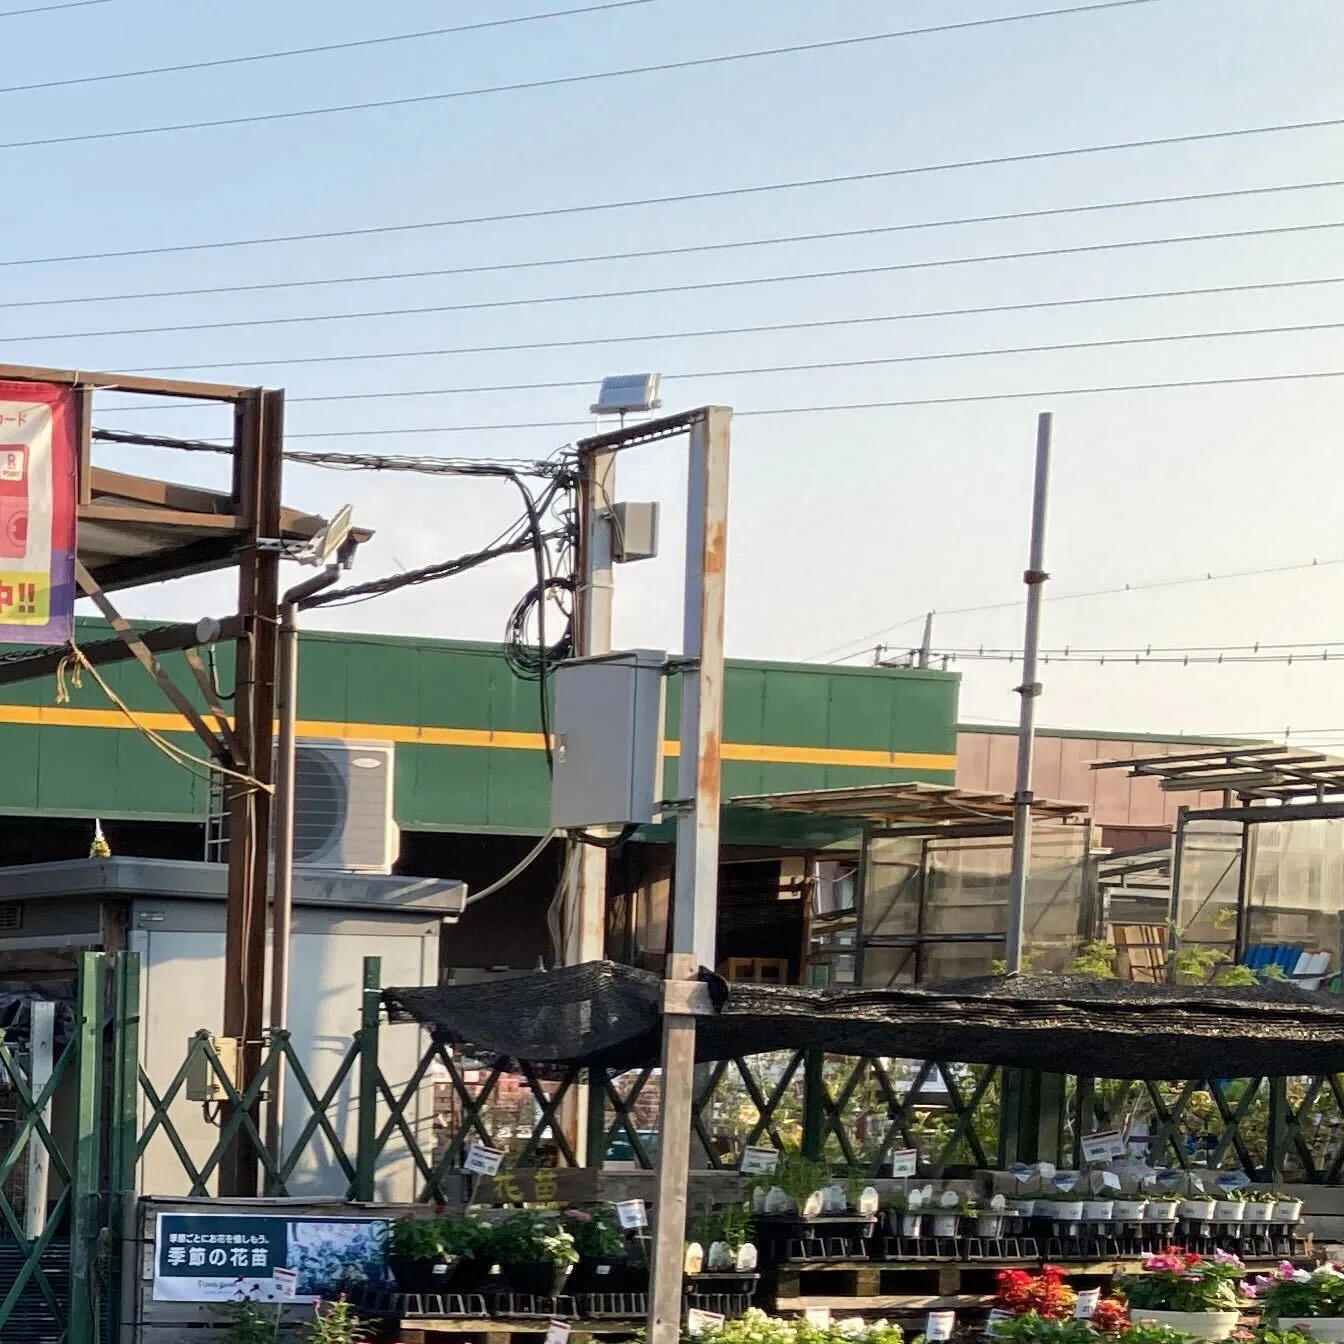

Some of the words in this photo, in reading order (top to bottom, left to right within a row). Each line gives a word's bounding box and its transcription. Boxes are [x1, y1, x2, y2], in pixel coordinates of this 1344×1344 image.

[167, 1247, 268, 1268] 季節の花苗
